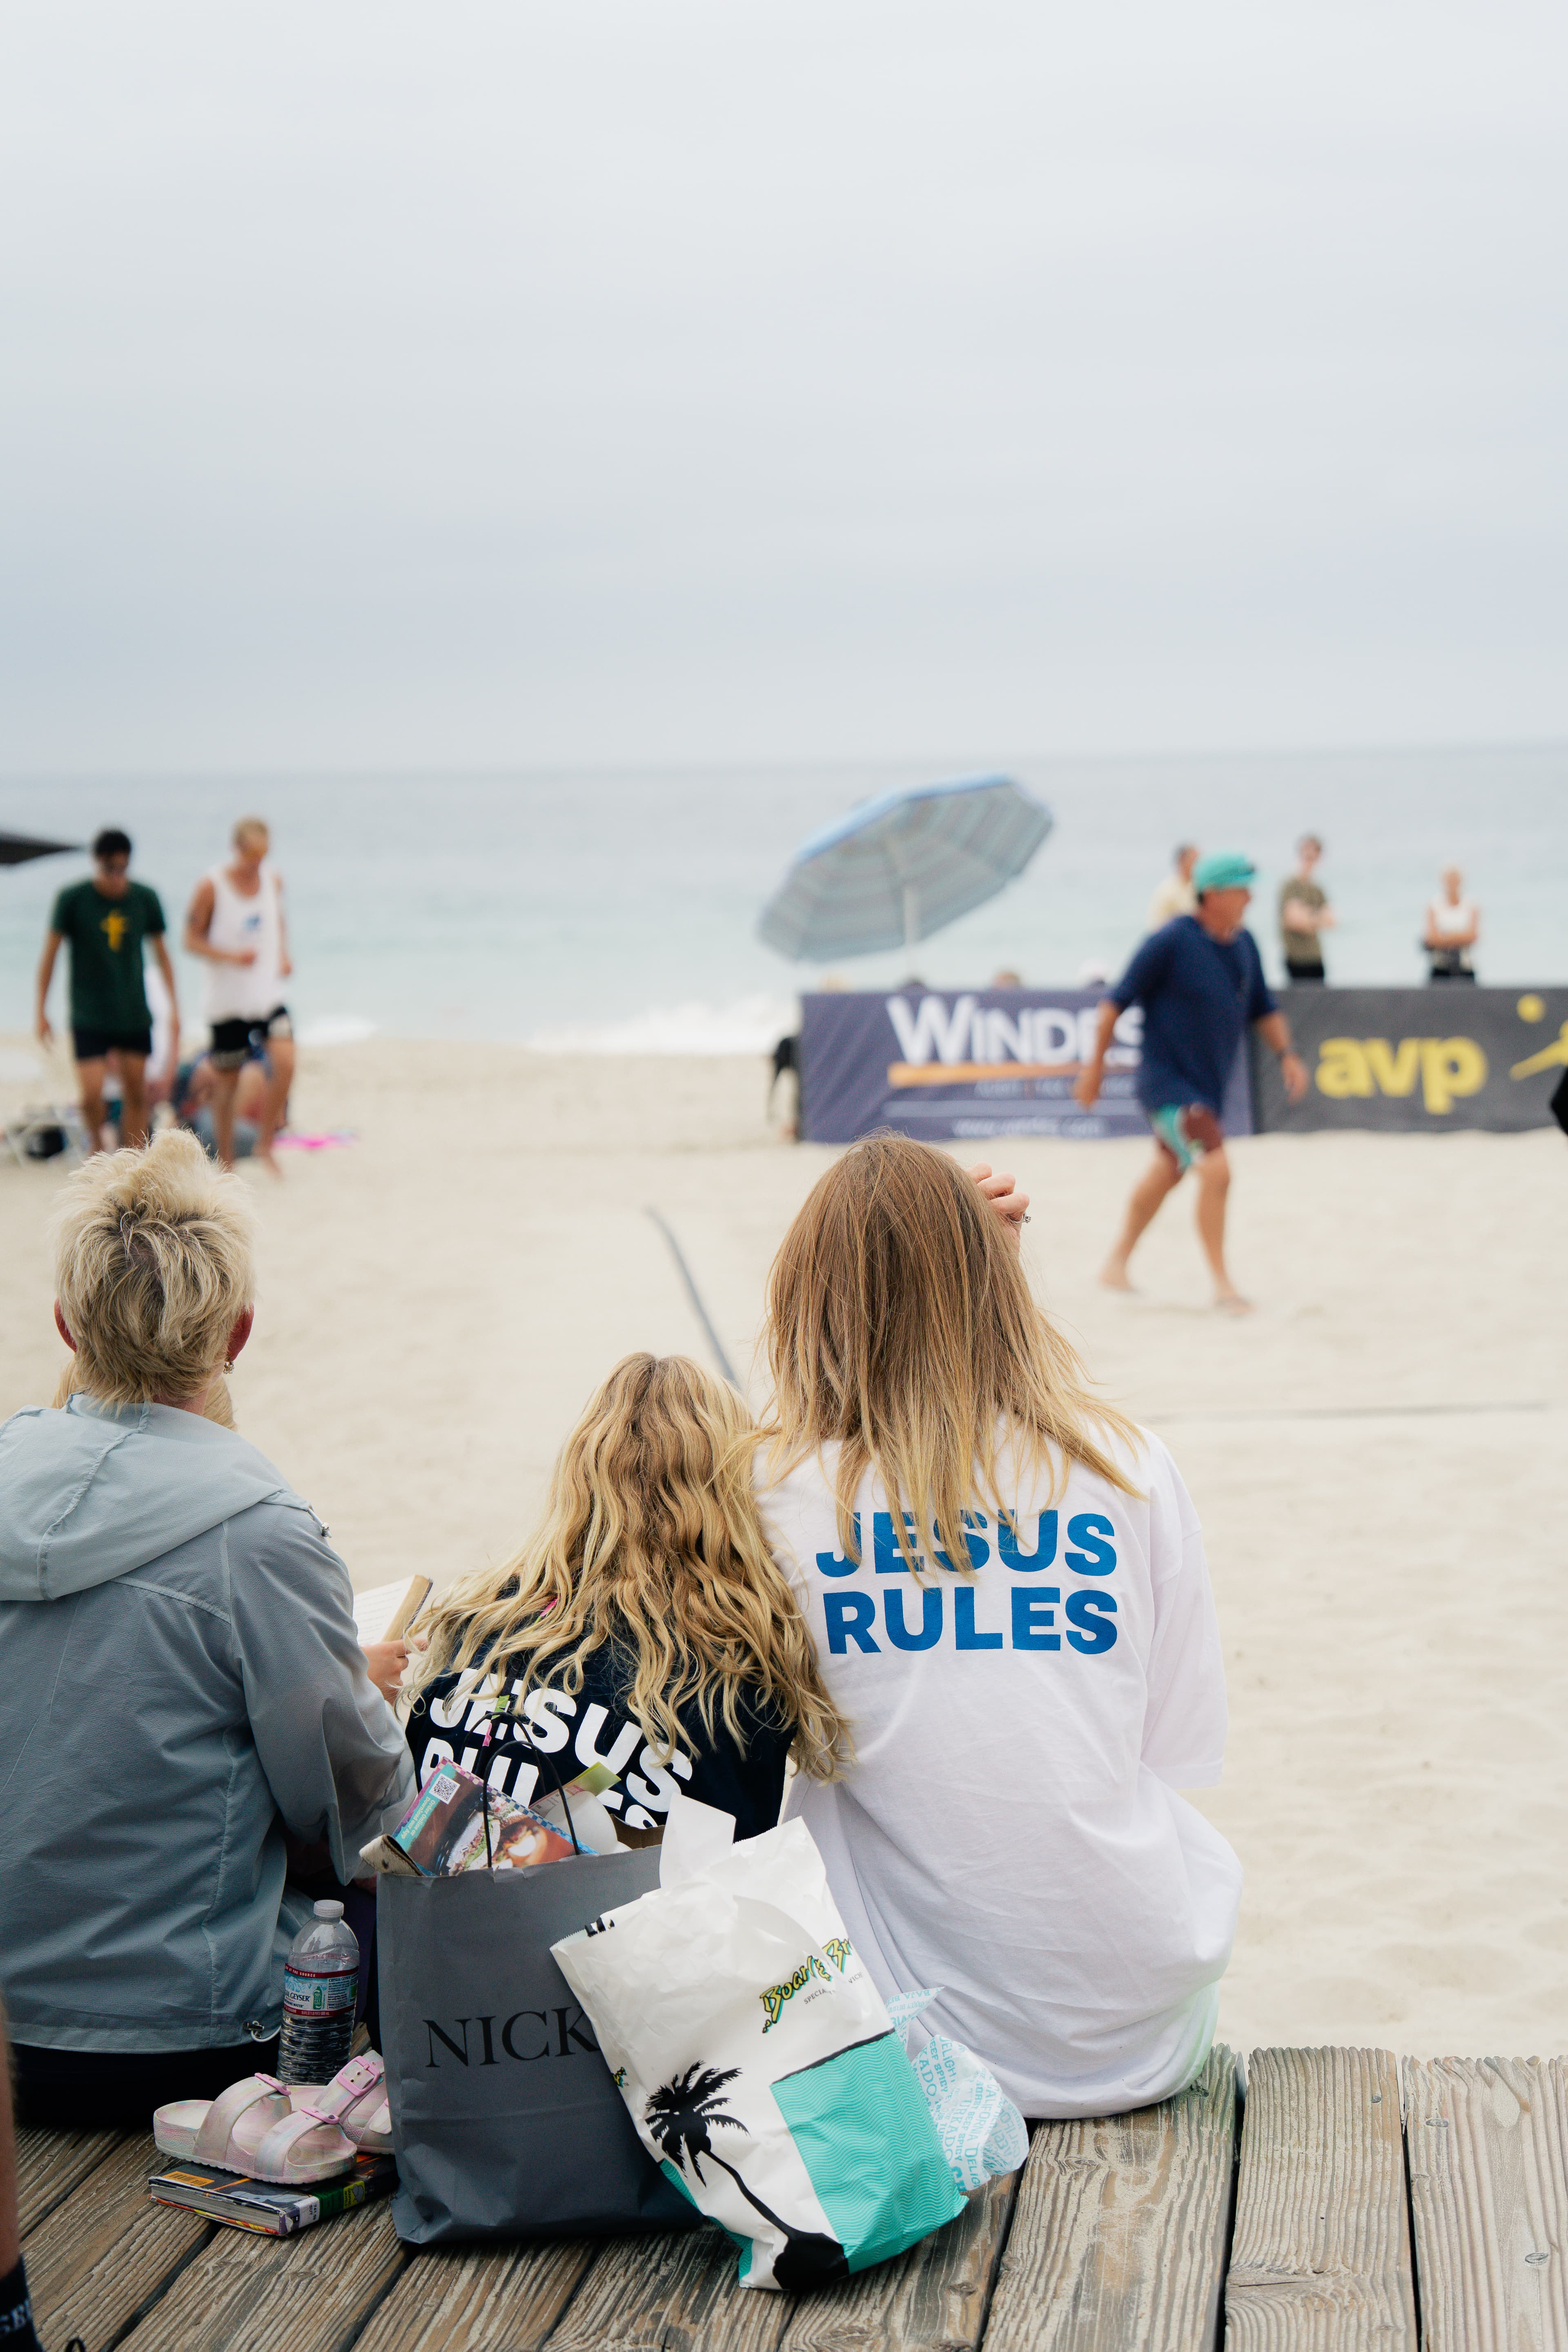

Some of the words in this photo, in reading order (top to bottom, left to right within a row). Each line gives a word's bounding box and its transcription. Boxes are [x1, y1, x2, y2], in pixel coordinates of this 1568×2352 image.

[1315, 1036, 1488, 1115] avp
[816, 1509, 1117, 1577] JESUS
[823, 1587, 1118, 1655] RULES
[430, 1668, 693, 1813] JESUS
[413, 1796, 430, 1821] Download
[425, 1800, 435, 1814] Order
[401, 1829, 410, 1839] App
[414, 1814, 426, 1829] Online
[290, 1992, 310, 2002] GEYSER
[803, 1988, 833, 2004] SPECIA
[422, 2005, 601, 2068] NICK
[929, 2036, 939, 2060] EEF
[967, 2083, 1000, 2142] CALIFORNIA
